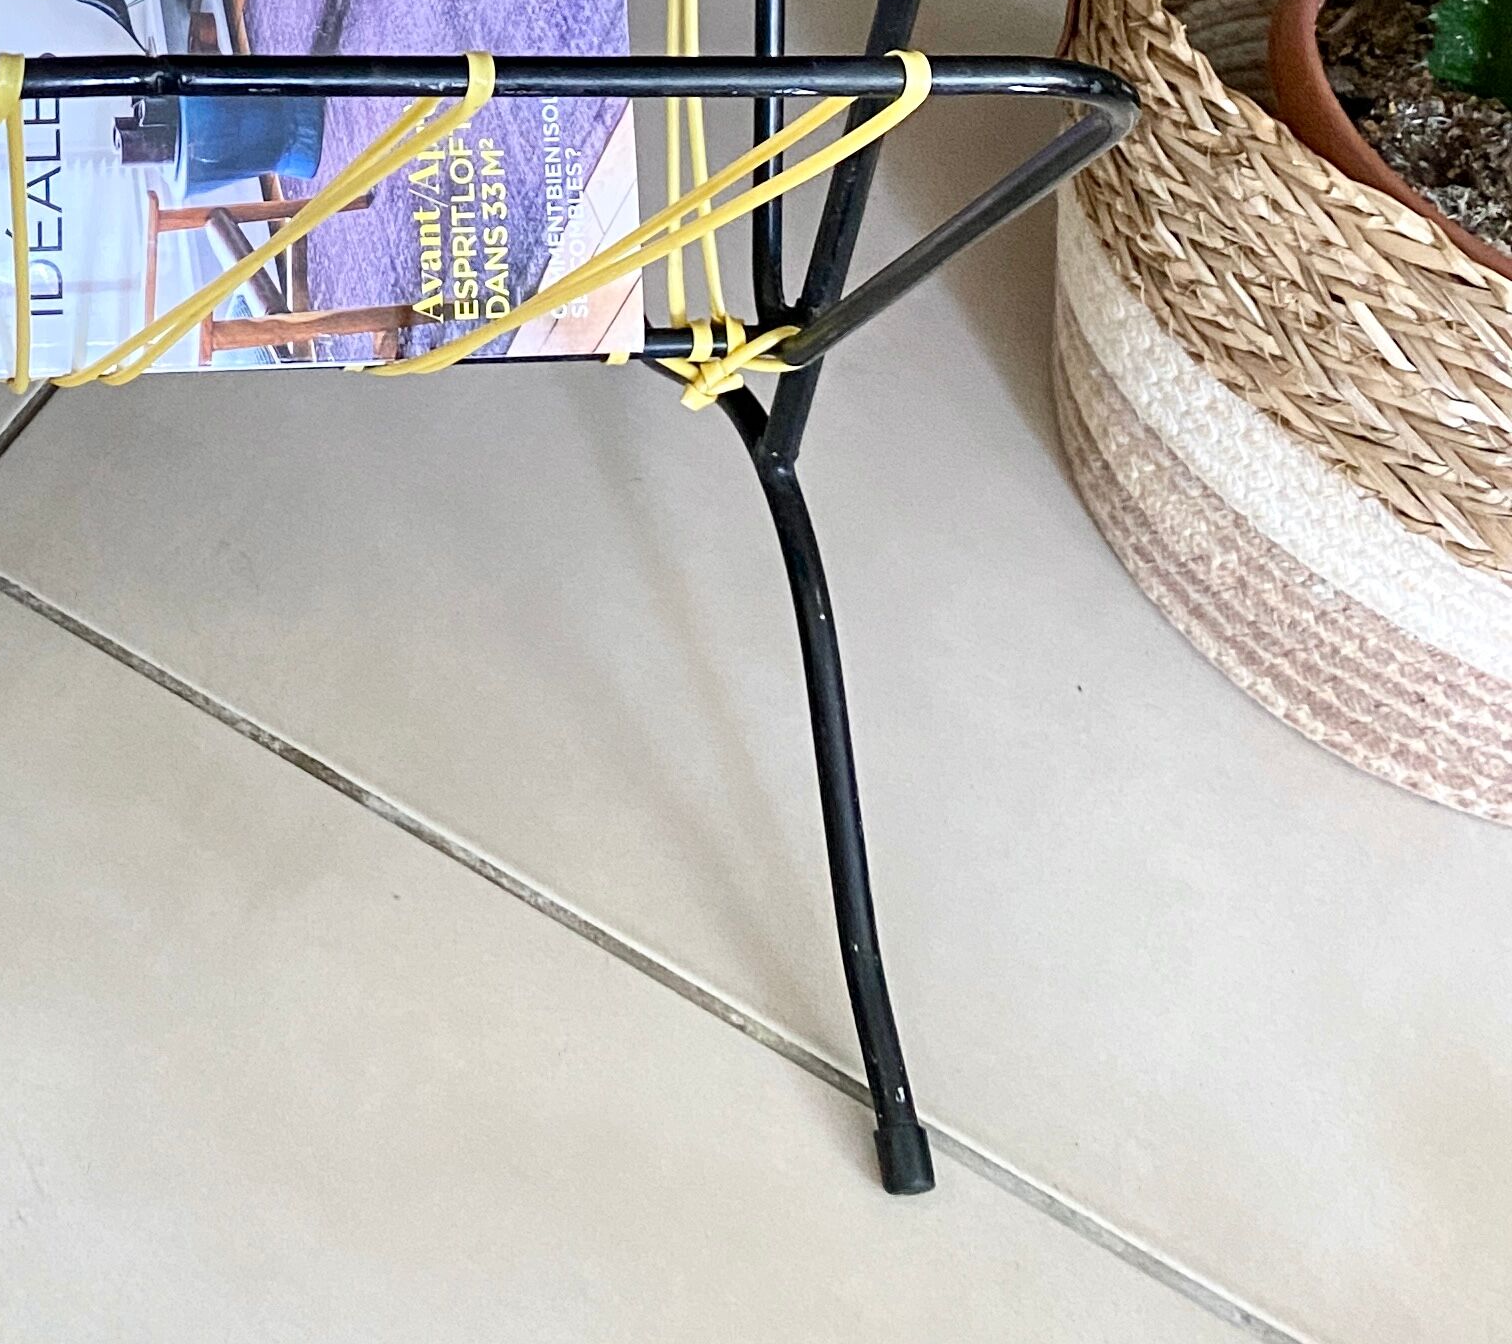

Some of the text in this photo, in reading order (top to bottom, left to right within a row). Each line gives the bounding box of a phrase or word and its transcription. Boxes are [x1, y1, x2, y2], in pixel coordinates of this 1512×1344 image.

[6, 52, 65, 317] IDÉALE
[481, 181, 508, 220] 33
[543, 146, 564, 200] BIEN
[450, 204, 480, 321] ESPRIT
[482, 224, 511, 319] DANS
[546, 201, 569, 320] CMMENT
